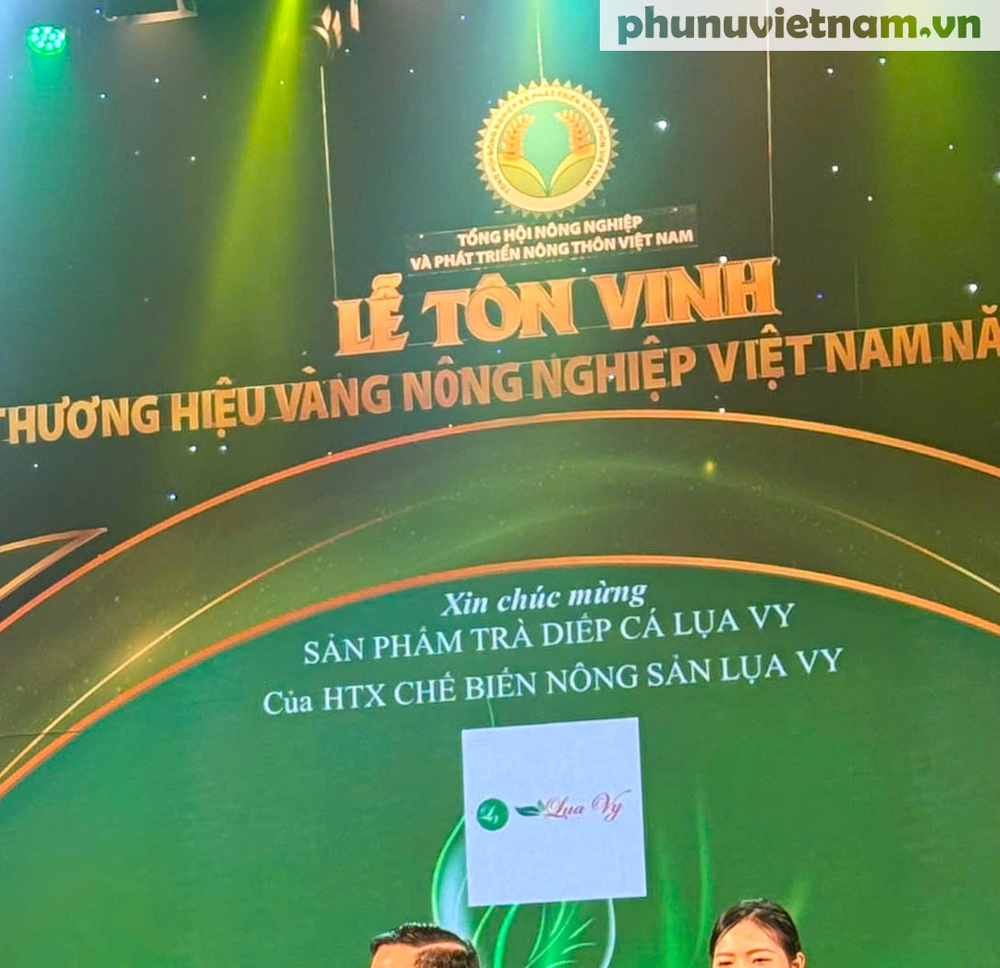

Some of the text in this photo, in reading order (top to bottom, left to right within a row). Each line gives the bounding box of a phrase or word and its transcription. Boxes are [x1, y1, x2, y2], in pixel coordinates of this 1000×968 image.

[410, 254, 432, 271] VÀ
[434, 250, 474, 268] PHÁT
[523, 241, 569, 260] NÔNG
[571, 237, 619, 255] THÔN
[618, 232, 653, 252] VIỆT
[656, 229, 695, 246] NAM
[503, 222, 533, 243] HỘI
[535, 218, 582, 240] NÔNG
[584, 214, 643, 234] NGHIỆP
[332, 257, 782, 357] LỄ TÔN VINH
[170, 376, 266, 439] HIỆU
[275, 365, 391, 422] VÀNG
[403, 355, 524, 412] NÔNG
[532, 335, 697, 403] NGHIỆP
[707, 323, 813, 390] VIỆT
[823, 322, 932, 373] NAM
[440, 580, 648, 617] Xin chúc mừng
[303, 633, 364, 665] SẢN
[470, 618, 533, 652] TRÀ
[542, 612, 612, 646] DIẾP
[619, 607, 665, 640] CÁ
[673, 608, 740, 639] LỤA
[748, 602, 796, 630] VY
[263, 647, 844, 716] Của HTX CHẾ BIẾN NÔNG SẢN LỤA VY
[591, 789, 632, 822] Vy
